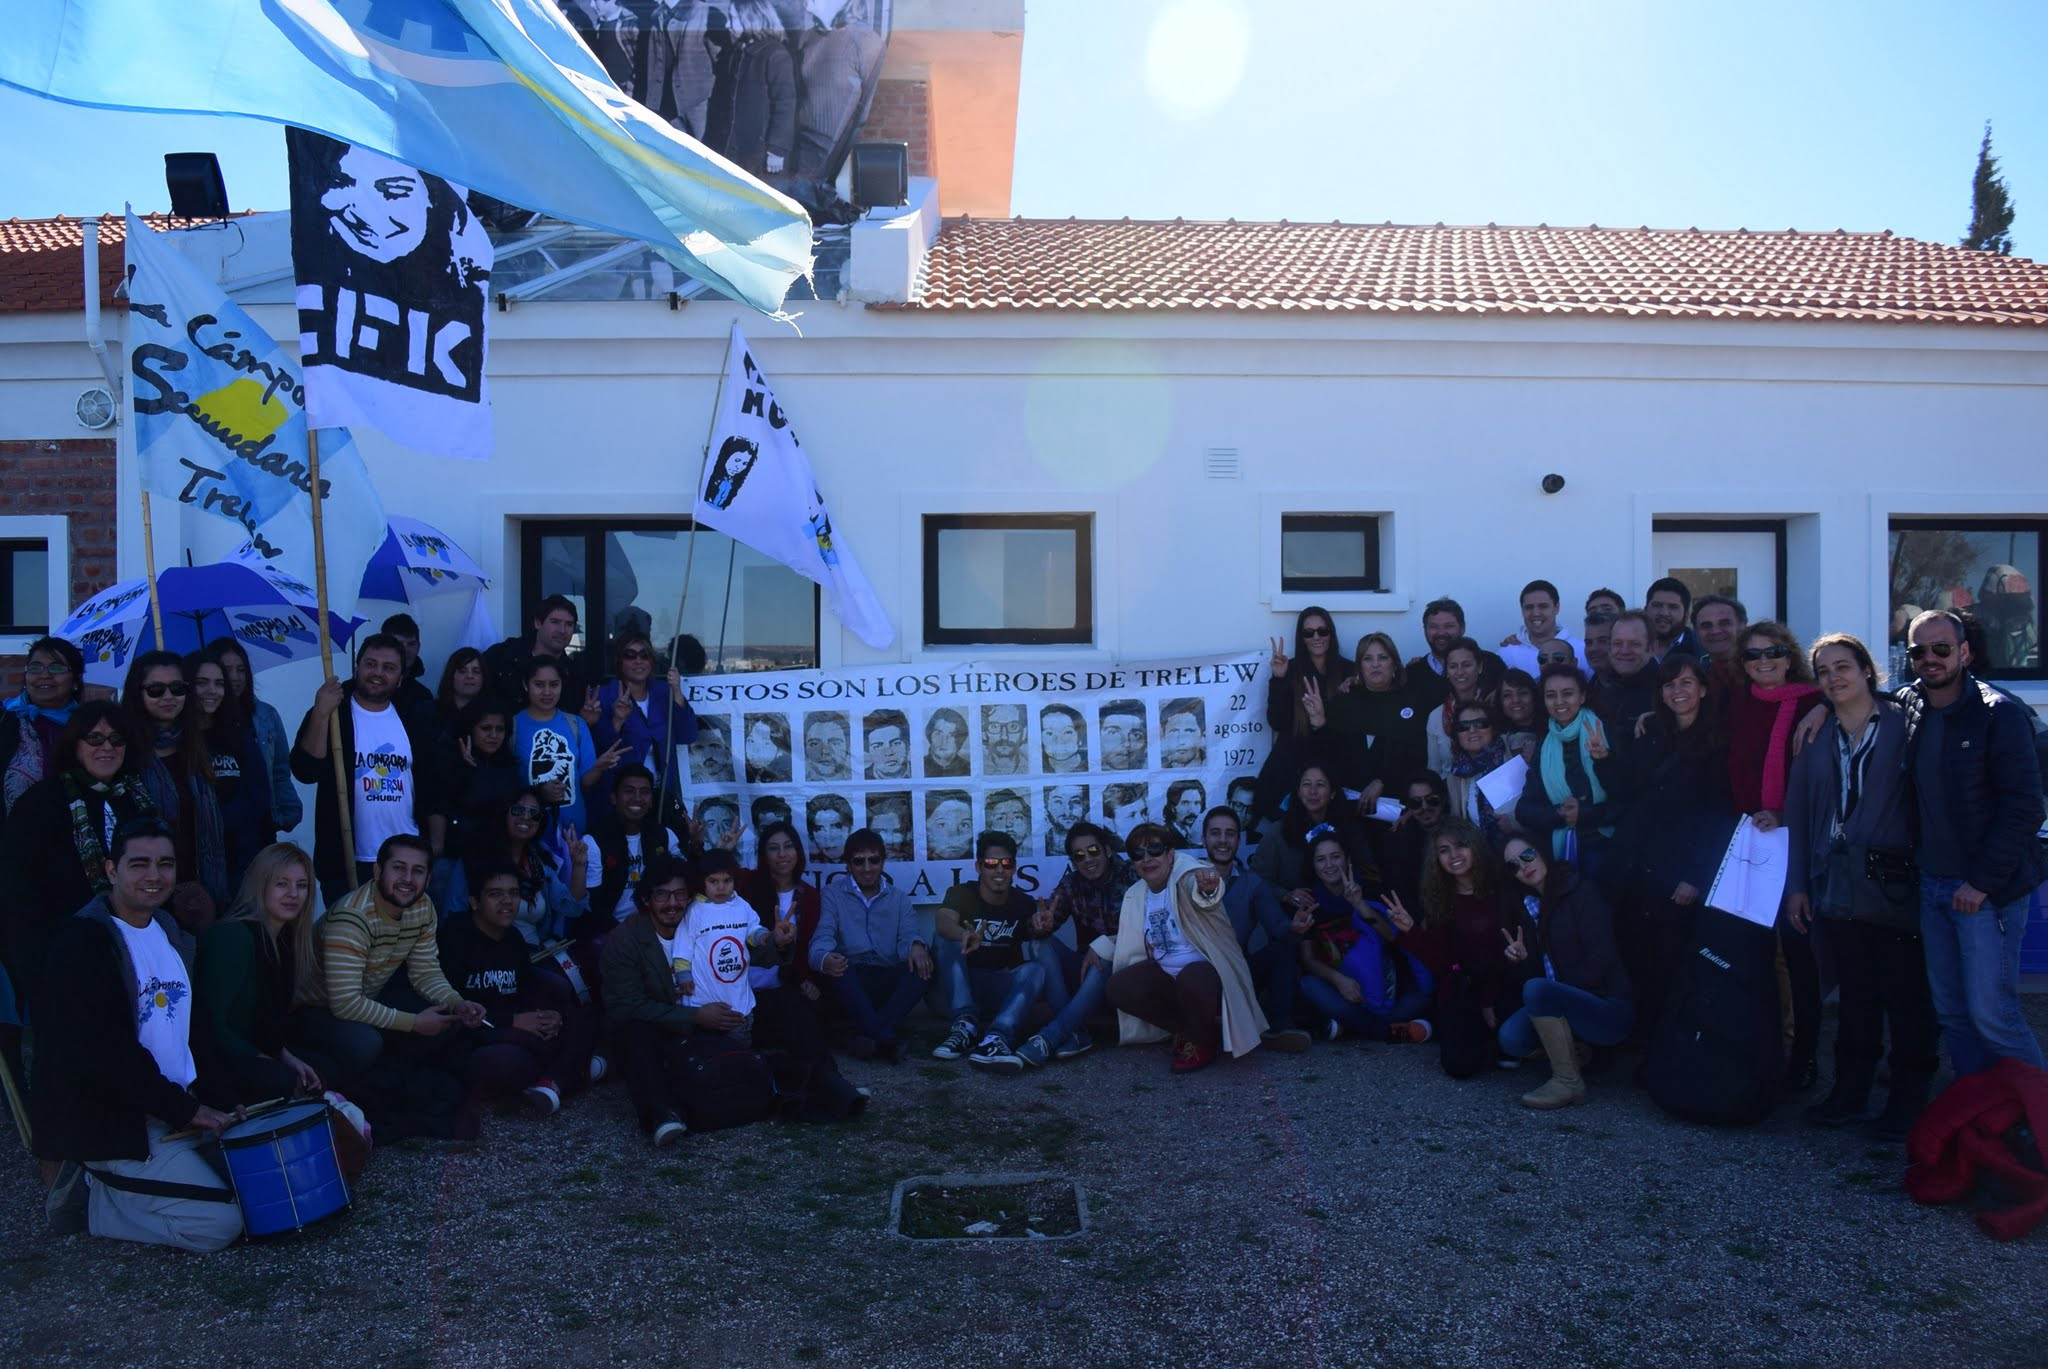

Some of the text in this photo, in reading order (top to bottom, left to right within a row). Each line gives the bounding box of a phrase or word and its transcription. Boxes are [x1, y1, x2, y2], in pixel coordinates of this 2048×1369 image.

[187, 313, 306, 411] Cámpo
[688, 661, 1260, 702] ESTOS SON LOS HEROES DE TRELEW
[1229, 694, 1247, 711] 22
[1213, 721, 1263, 738] agosto
[1223, 749, 1255, 767] 1972
[366, 794, 402, 802] CHUBUT
[465, 972, 481, 989] LA
